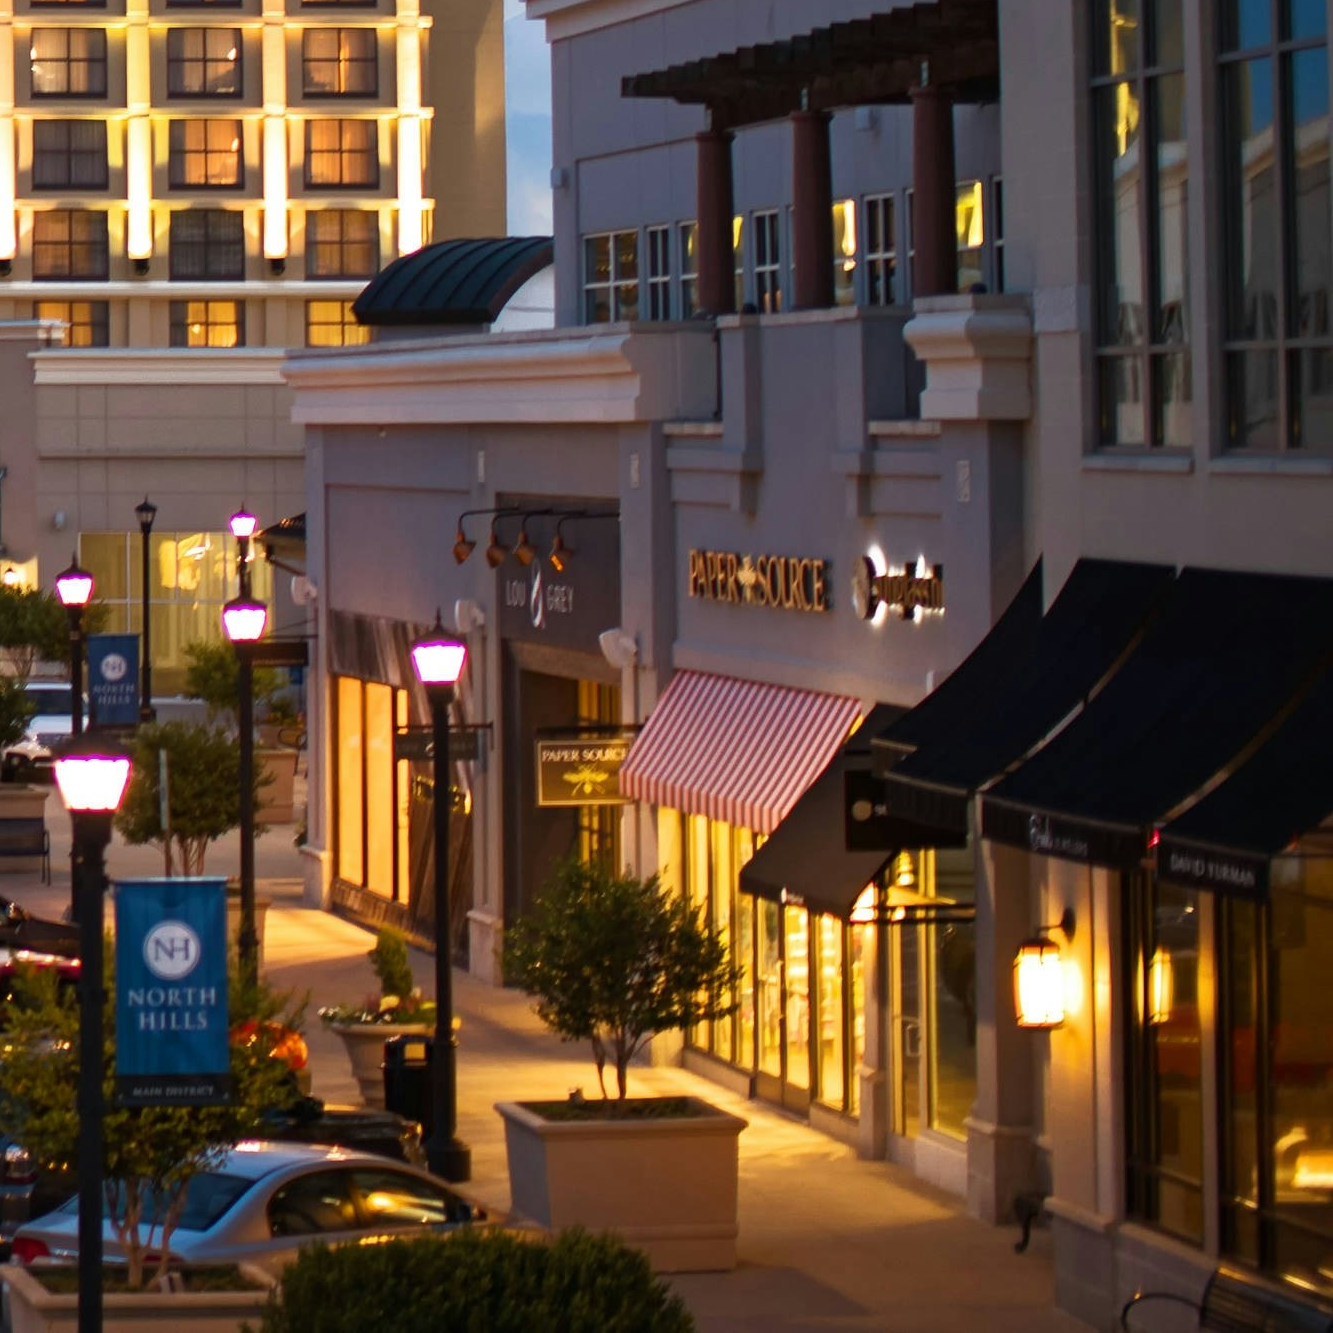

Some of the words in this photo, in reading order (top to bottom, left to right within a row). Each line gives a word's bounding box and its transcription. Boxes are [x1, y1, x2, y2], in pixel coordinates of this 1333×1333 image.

[688, 548, 740, 603] PAPER
[757, 553, 827, 612] SOURCE
[541, 749, 580, 762] PAPER
[153, 937, 191, 963] NH
[128, 987, 217, 1007] NORTH
[138, 1010, 209, 1031] HILLS
[133, 1087, 163, 1097] MAIN
